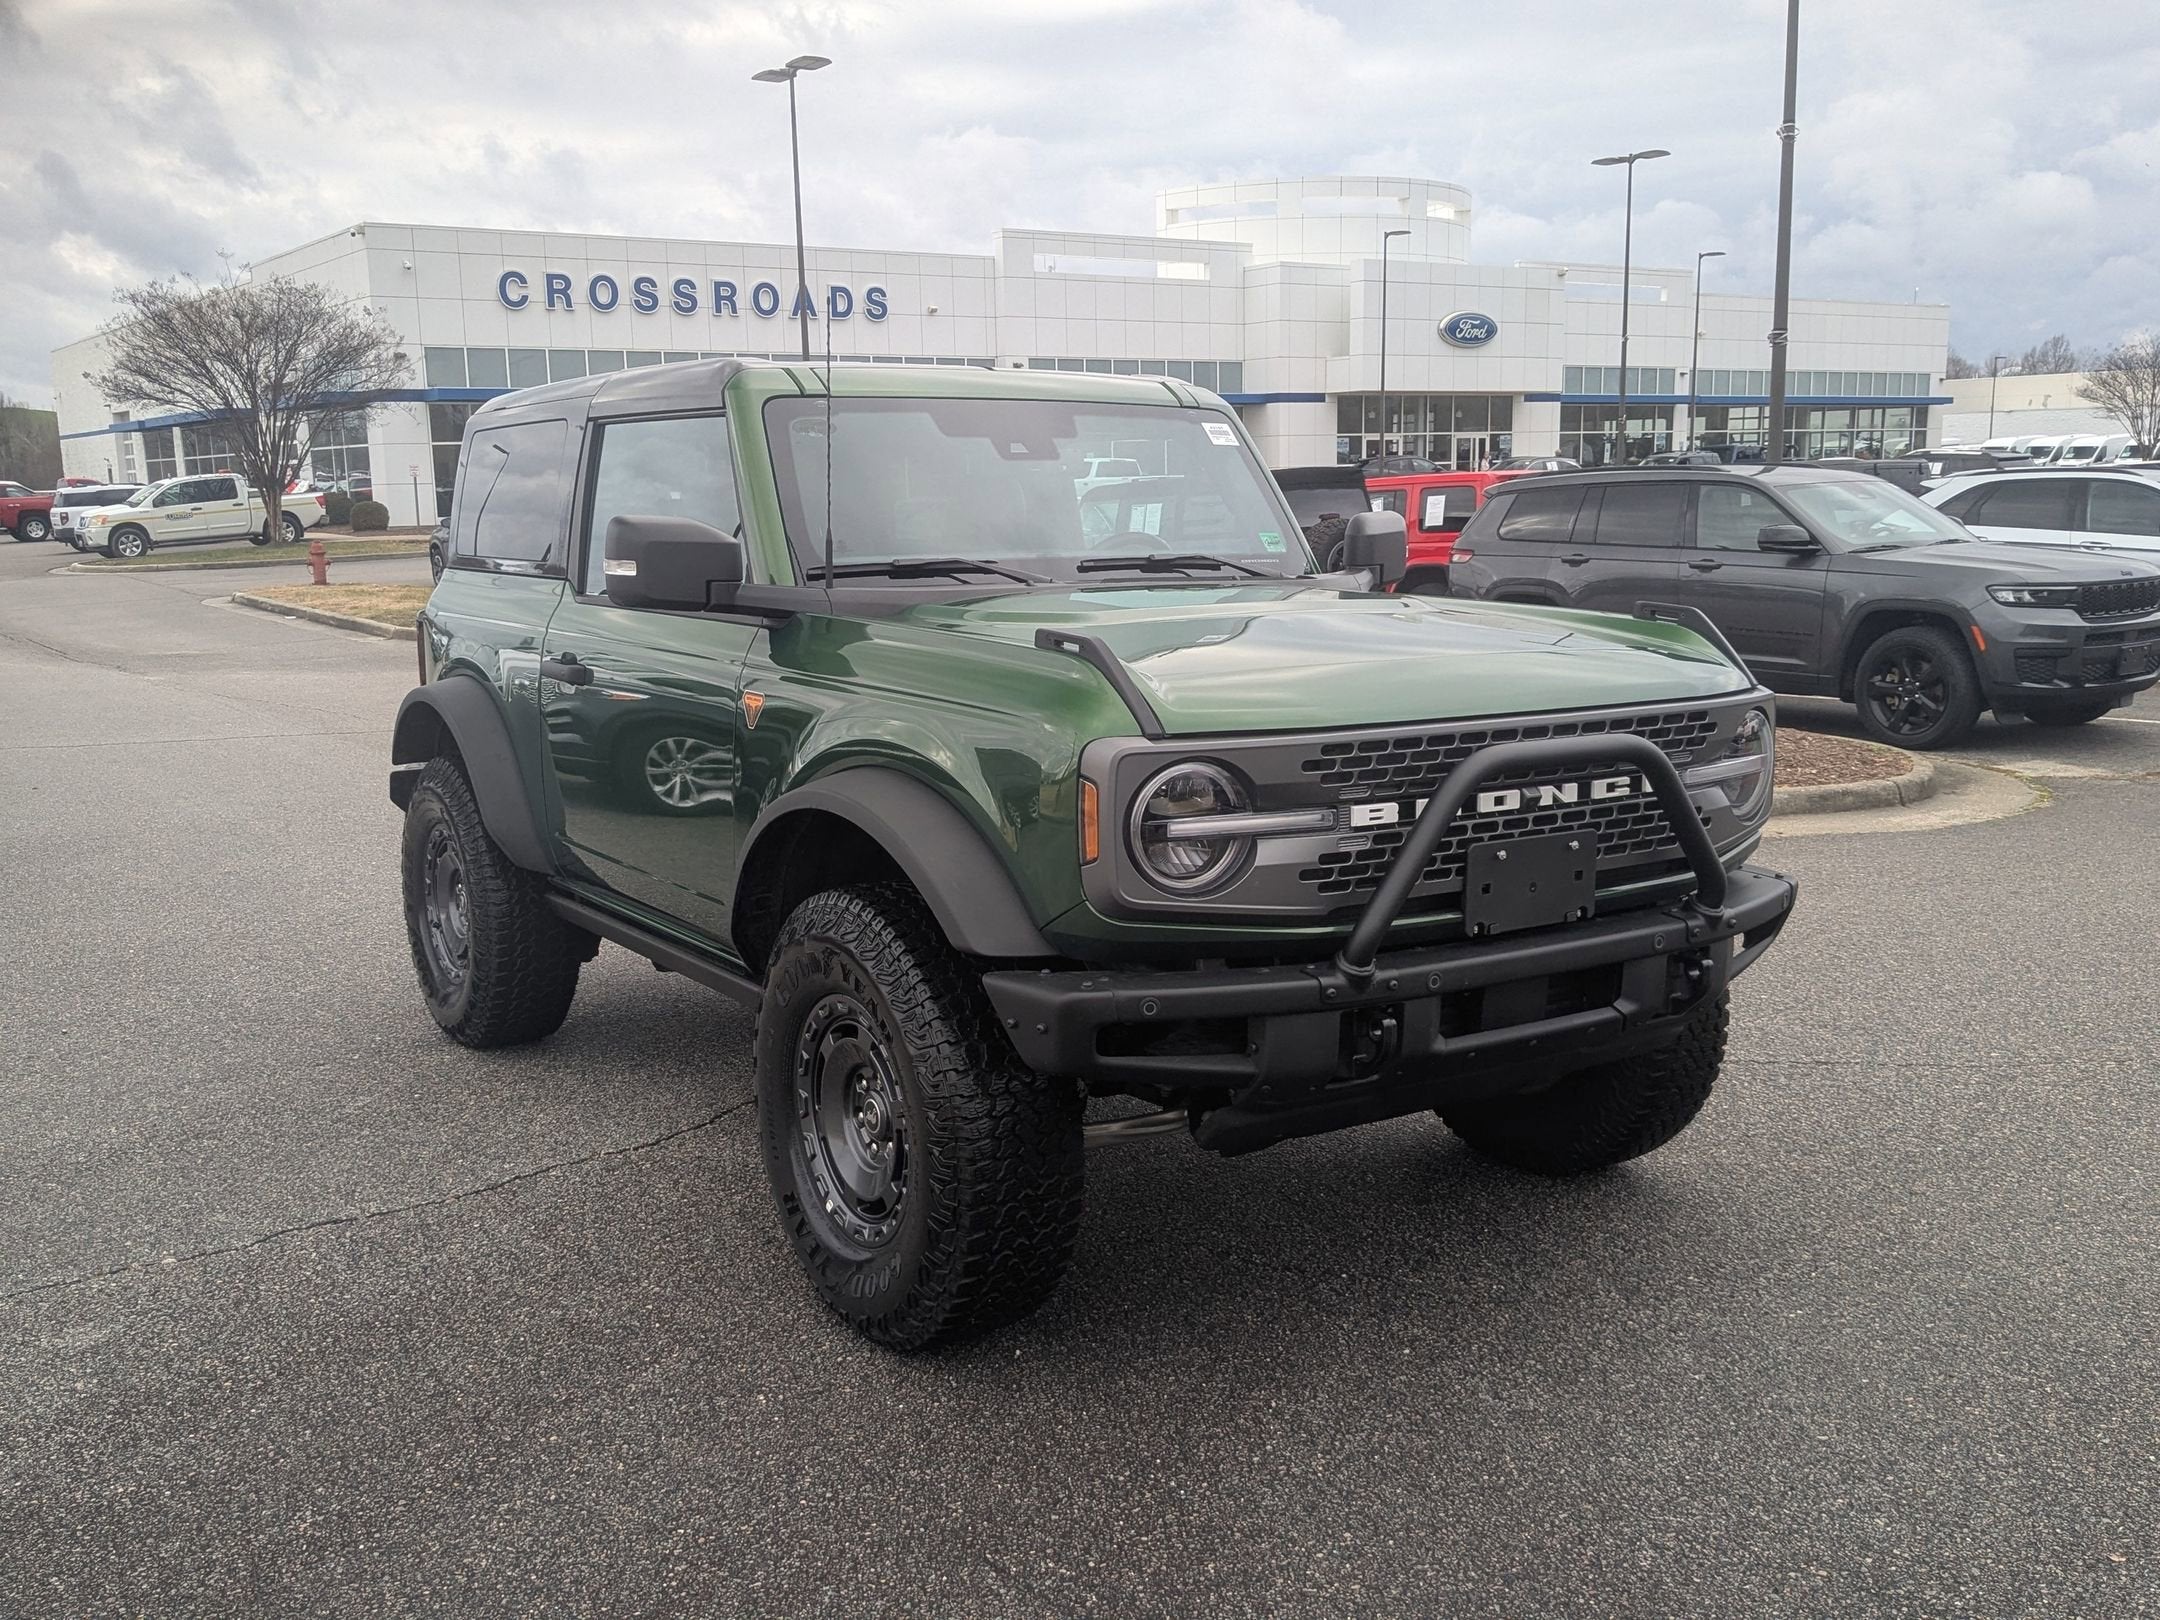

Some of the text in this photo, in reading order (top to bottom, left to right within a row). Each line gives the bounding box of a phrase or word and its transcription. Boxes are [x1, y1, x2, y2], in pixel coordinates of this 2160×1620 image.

[497, 270, 890, 322] CROSSROADS
[1455, 319, 1488, 339] Ford
[1350, 775, 1654, 828] BONC
